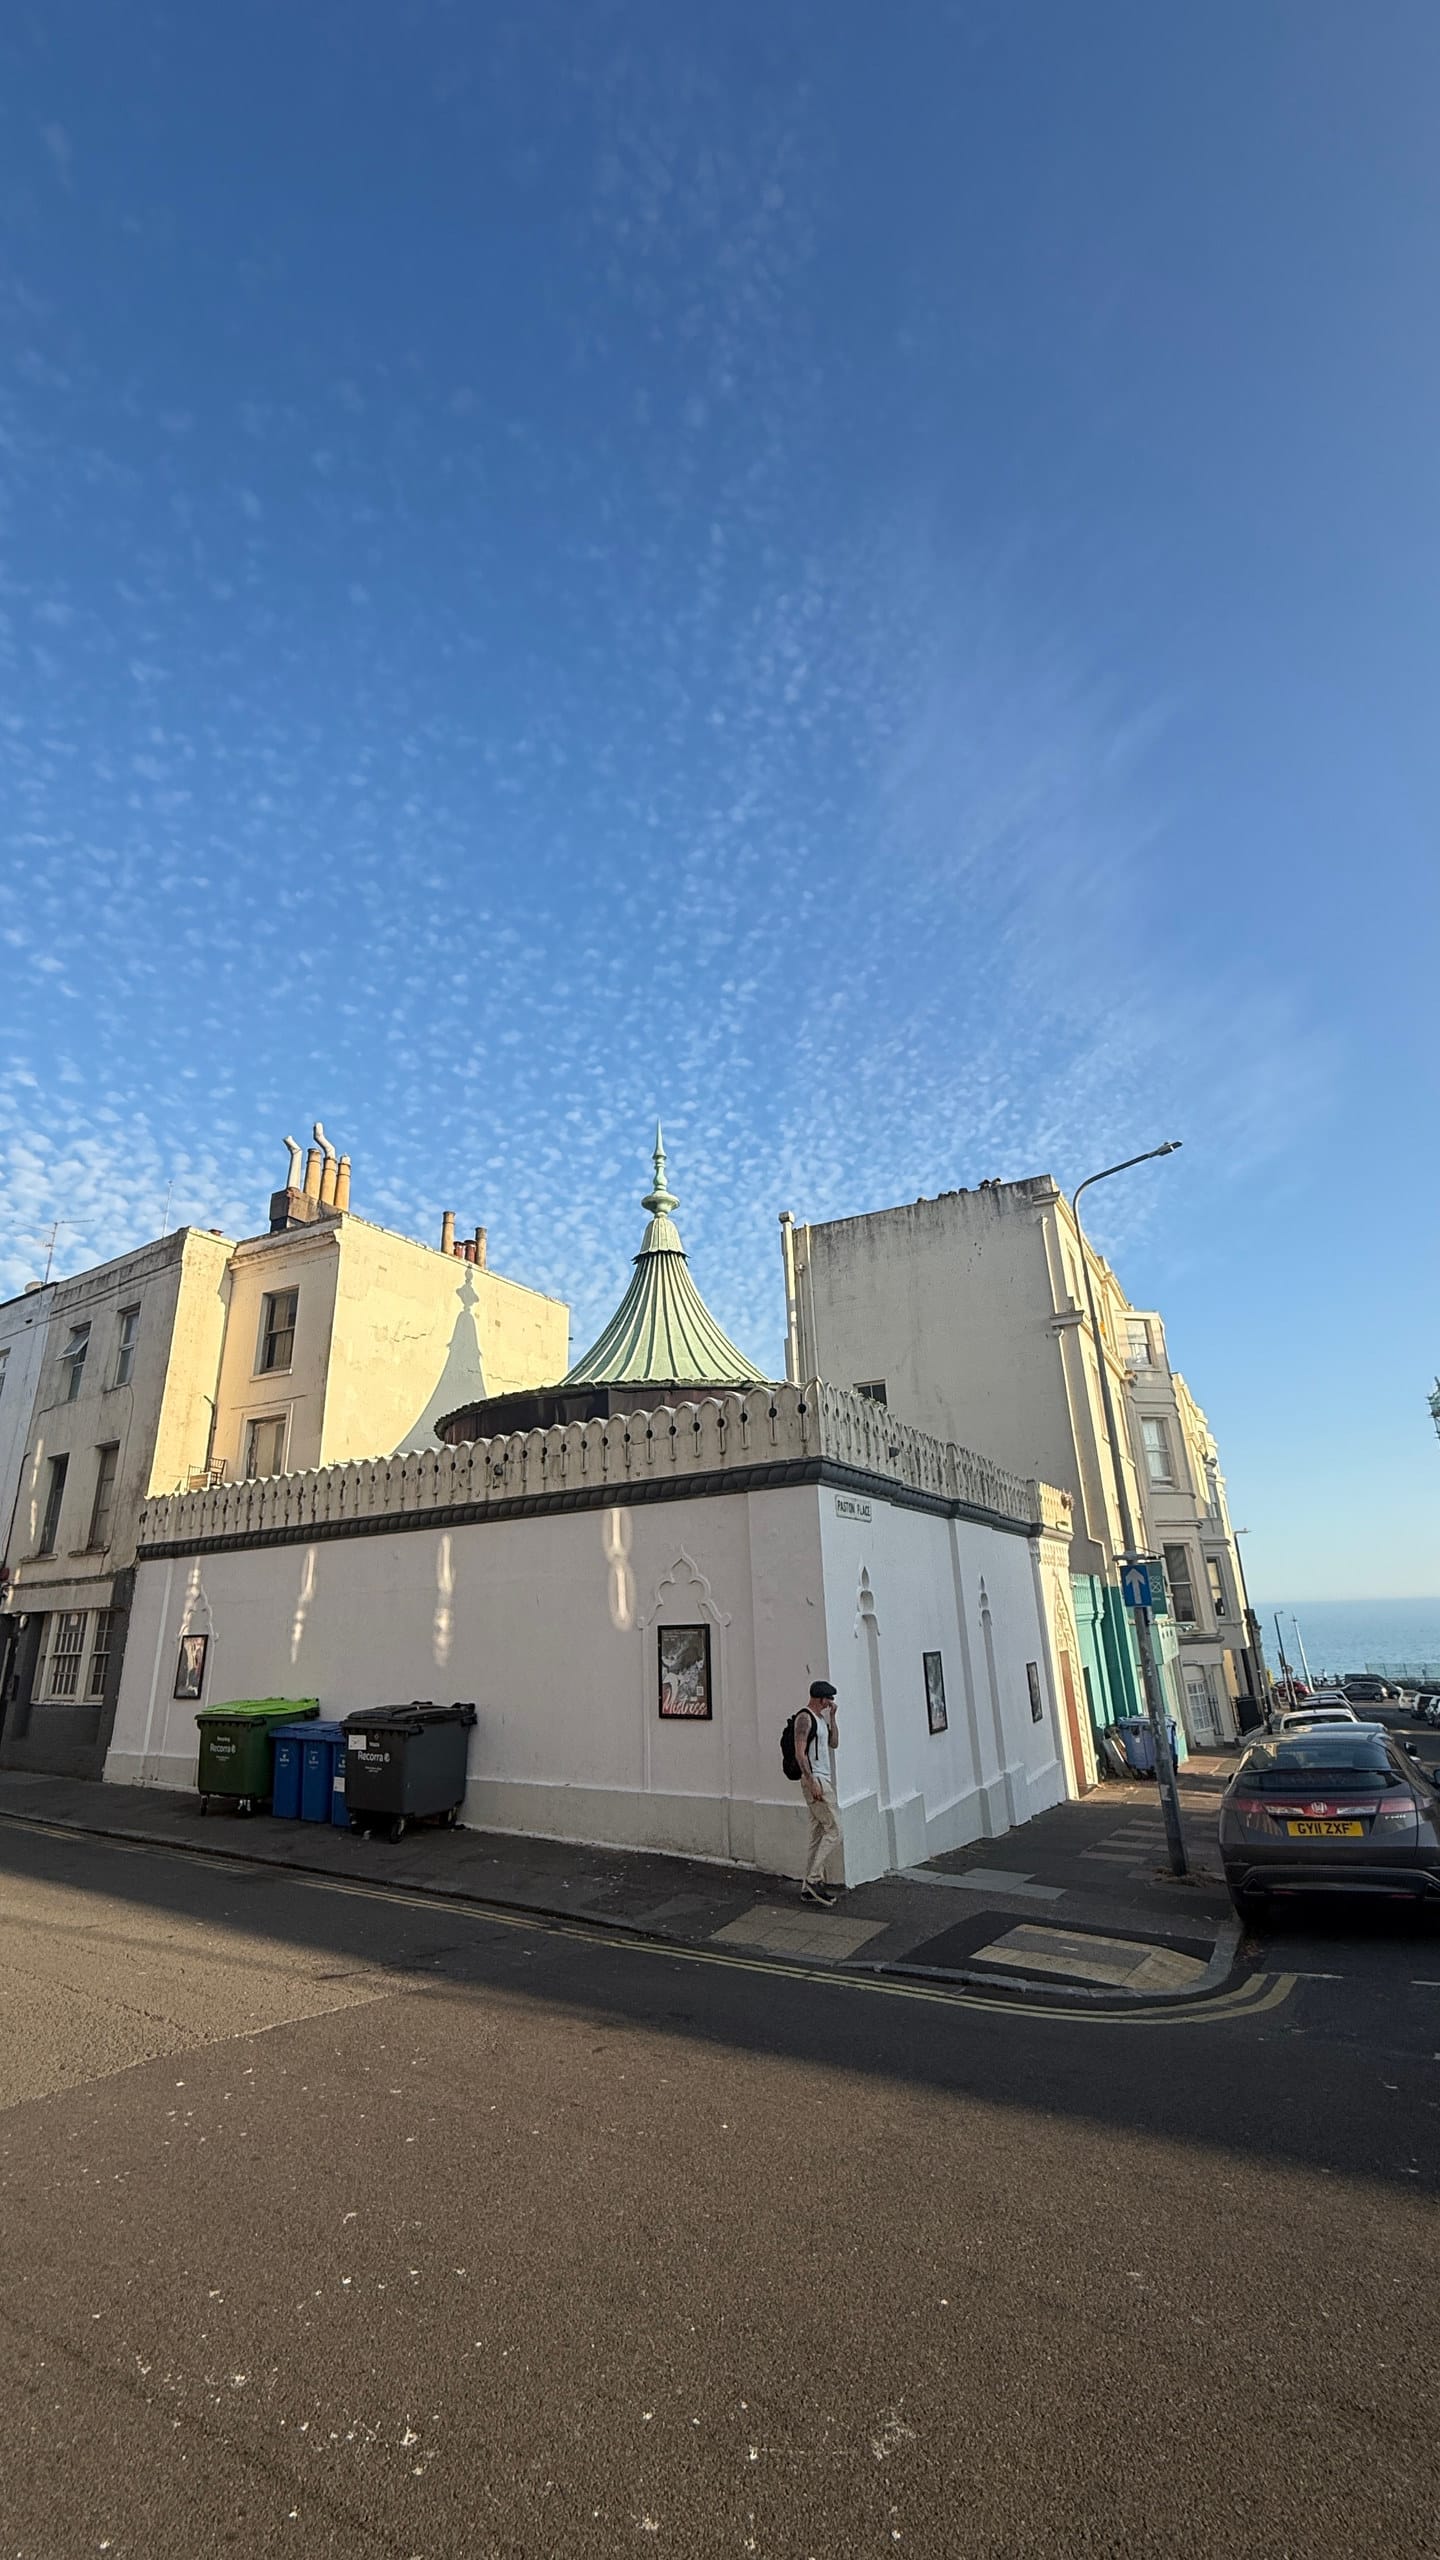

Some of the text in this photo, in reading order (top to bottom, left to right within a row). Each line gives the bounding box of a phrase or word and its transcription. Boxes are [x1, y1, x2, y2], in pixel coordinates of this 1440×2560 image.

[837, 1500, 871, 1516] PASTON PLACE
[662, 1689, 707, 1715] Mistress
[210, 1743, 231, 1752] Recorra
[357, 1750, 383, 1762] Recorra
[1297, 1822, 1350, 1834] GY11 ZXF
